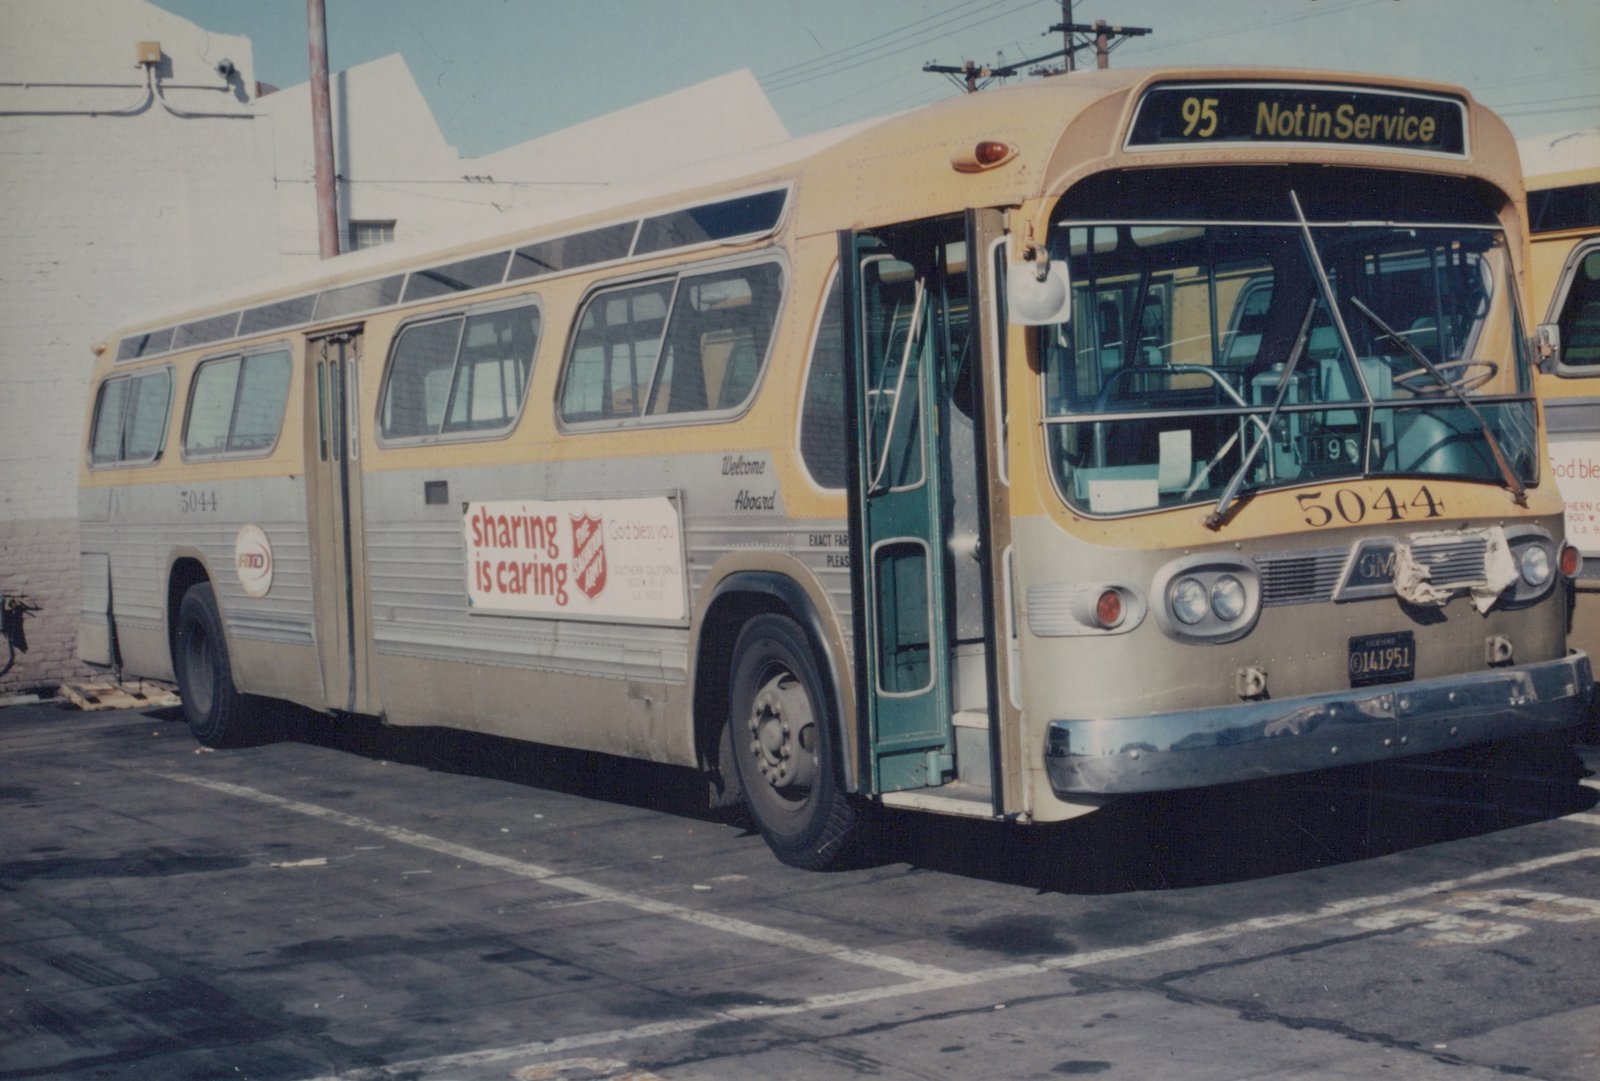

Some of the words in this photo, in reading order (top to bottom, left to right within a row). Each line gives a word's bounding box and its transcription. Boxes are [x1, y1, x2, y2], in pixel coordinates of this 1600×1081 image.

[1181, 97, 1218, 138] 95
[1255, 101, 1304, 137] Not
[1307, 103, 1329, 137] in
[1335, 103, 1436, 142] Service
[721, 454, 766, 475] Welcome
[180, 489, 218, 513] 5044
[735, 489, 776, 510] Aboard
[1295, 484, 1445, 527] 5044
[471, 505, 559, 560] sharing
[809, 533, 832, 548] EXACT
[238, 552, 265, 569] RTD
[475, 551, 493, 593] is
[496, 552, 569, 607] caring
[1362, 646, 1409, 673] 141951
